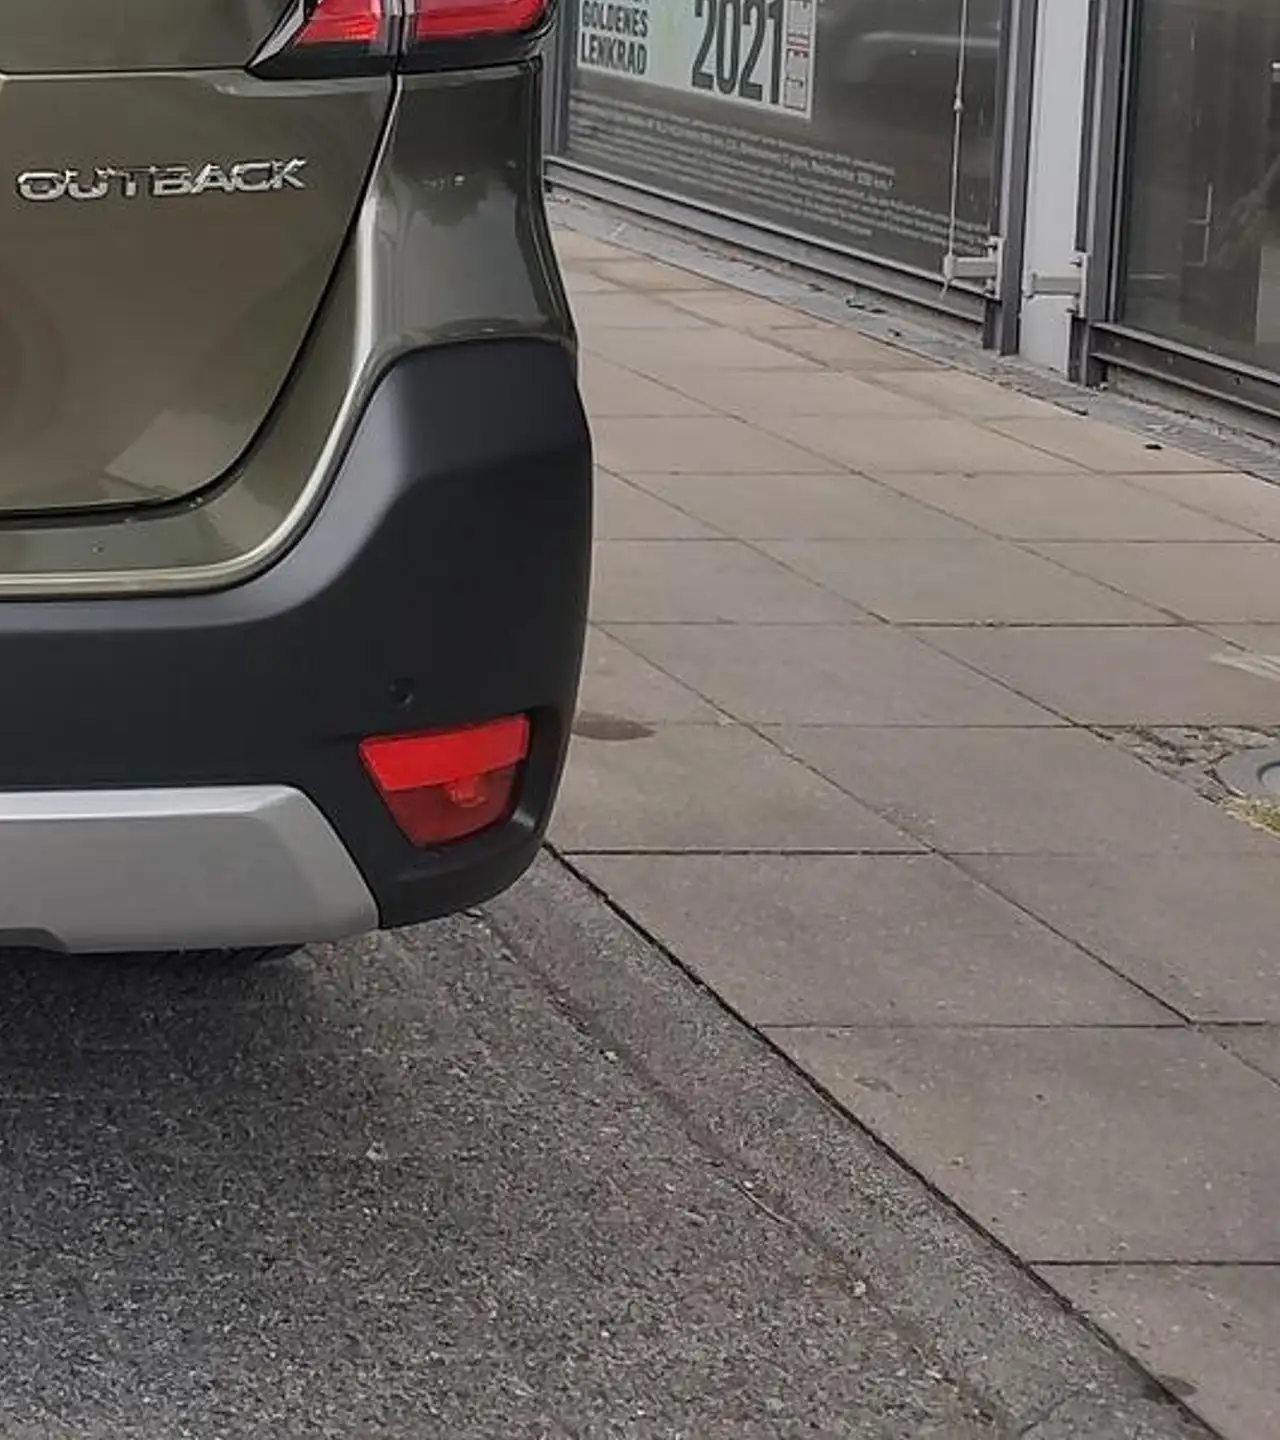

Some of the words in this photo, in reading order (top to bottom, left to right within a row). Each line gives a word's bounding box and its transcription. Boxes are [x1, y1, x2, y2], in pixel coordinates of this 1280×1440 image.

[582, 0, 649, 39] GOLDENES
[580, 33, 647, 76] LENKRAD
[16, 158, 308, 202] OUTBACK
